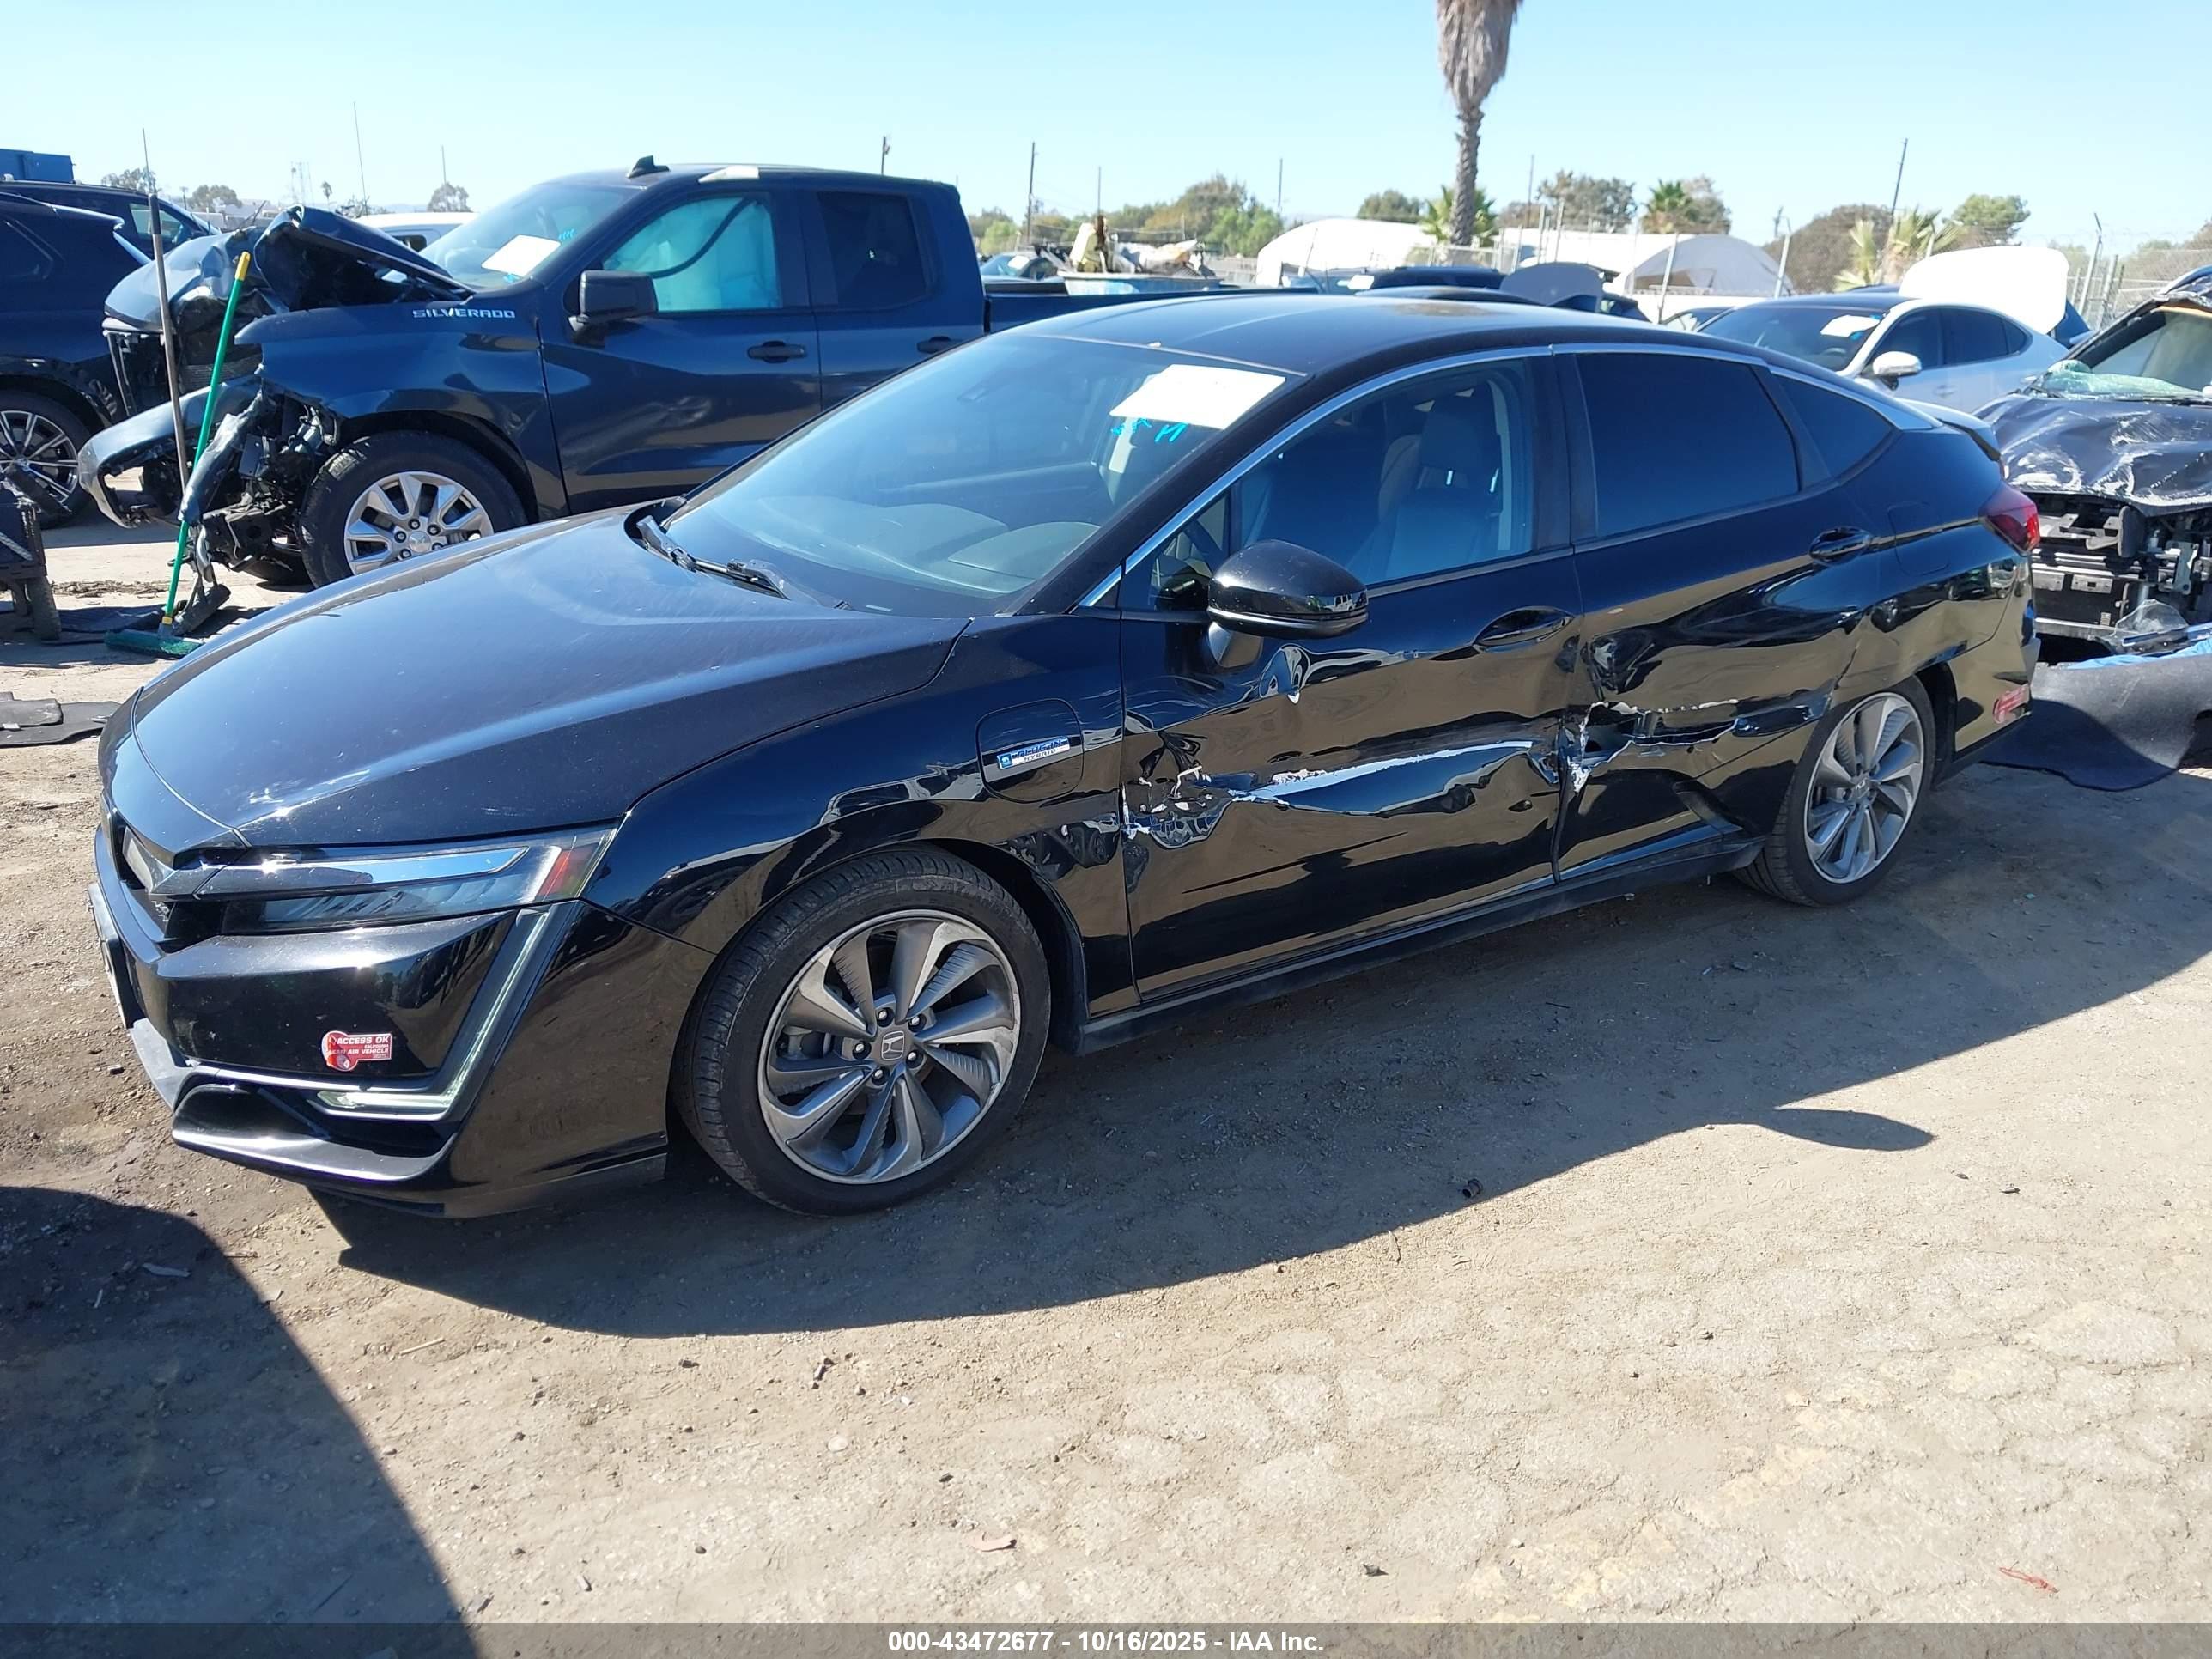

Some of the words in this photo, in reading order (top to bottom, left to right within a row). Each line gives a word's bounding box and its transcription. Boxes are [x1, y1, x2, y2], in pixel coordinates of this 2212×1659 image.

[412, 307, 516, 319] SILVERADO
[337, 1036, 373, 1045] ACCESS
[375, 1036, 390, 1044] OK
